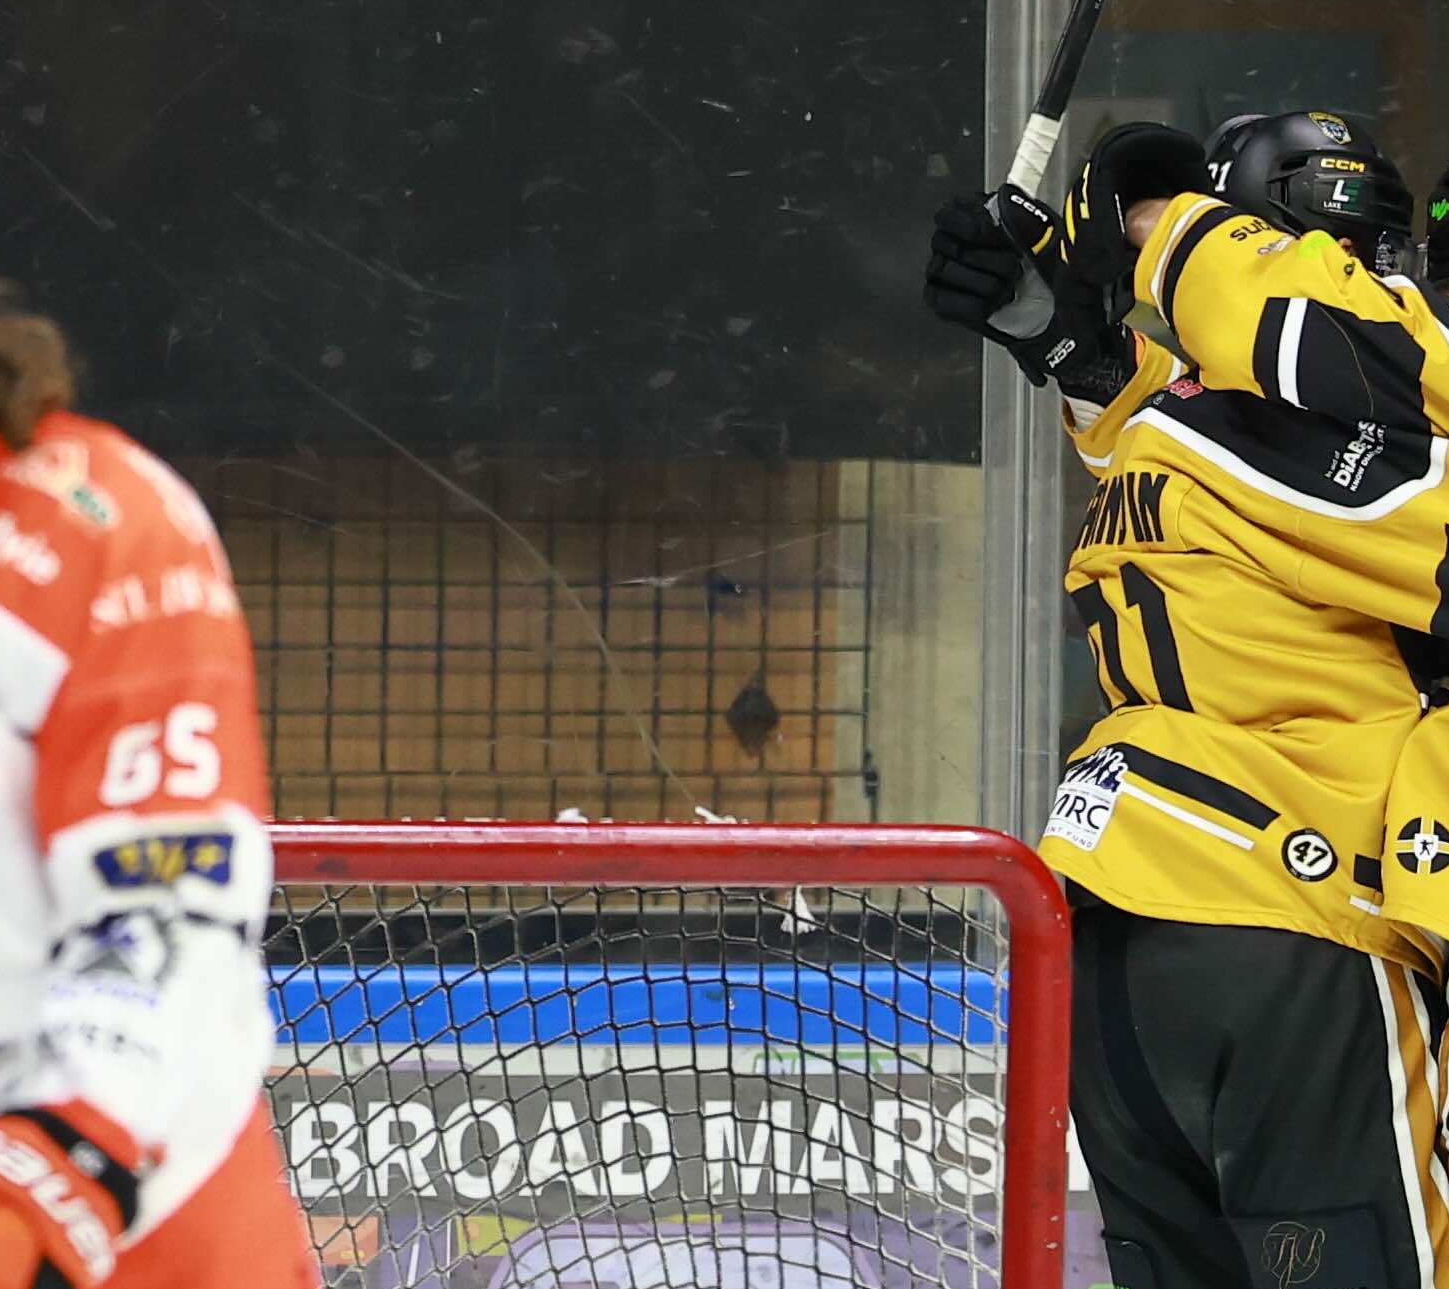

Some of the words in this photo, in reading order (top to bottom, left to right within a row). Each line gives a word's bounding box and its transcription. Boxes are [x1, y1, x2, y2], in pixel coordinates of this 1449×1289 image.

[1320, 158, 1366, 173] CCM
[1010, 194, 1048, 223] CCM
[100, 702, 223, 808] 65
[1293, 840, 1329, 868] 47
[287, 1099, 672, 1201] BROAD
